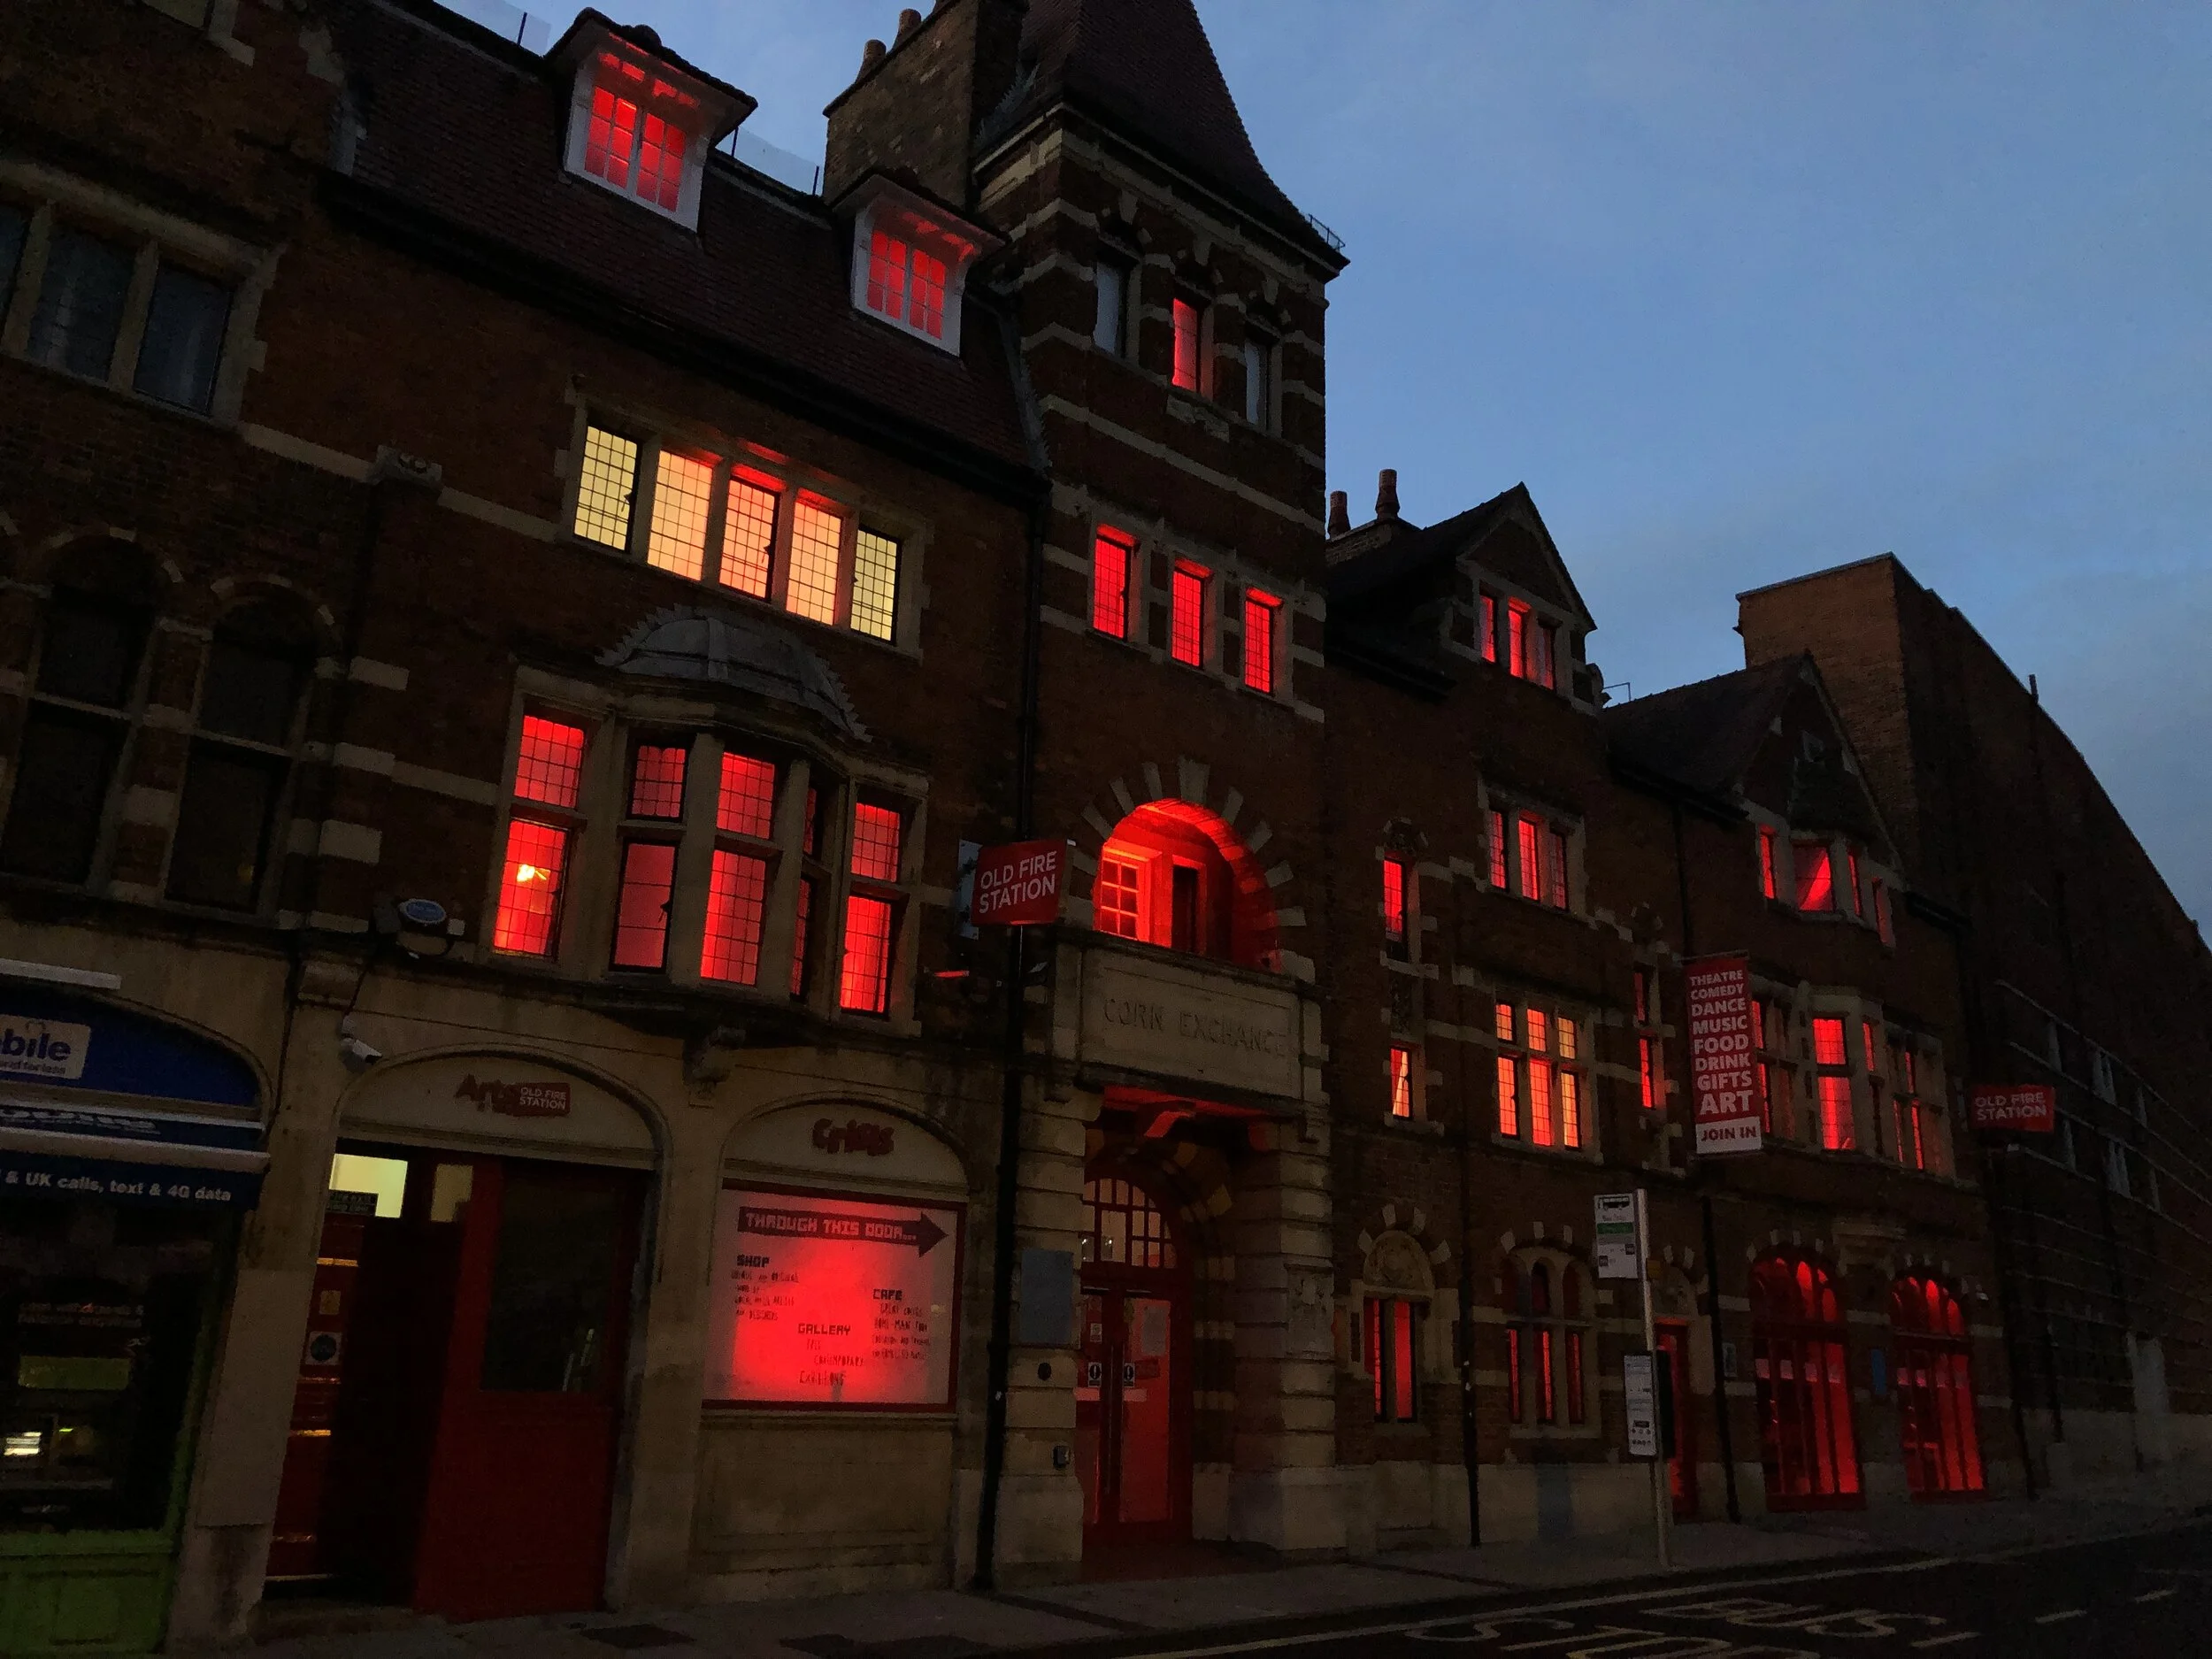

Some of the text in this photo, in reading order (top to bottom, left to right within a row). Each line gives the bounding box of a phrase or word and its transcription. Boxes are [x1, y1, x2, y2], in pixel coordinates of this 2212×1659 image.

[980, 850, 1057, 889] OLD FIRE
[979, 873, 1056, 913] STATION
[1689, 970, 1744, 987] THEATRE
[1691, 983, 1744, 1000] COMEDY
[1103, 998, 1164, 1032] CORN
[1692, 997, 1747, 1017] DANCE
[1693, 1015, 1747, 1034] MUSIC
[0, 1029, 71, 1061] bile
[1694, 1033, 1748, 1054] FOOD
[1695, 1053, 1751, 1071] DRINK
[1697, 1071, 1752, 1091] GIFTS
[520, 1087, 566, 1101] OLD FIRE
[1700, 1090, 1753, 1115] ART
[1975, 1092, 2046, 1108] OLD FIRE
[519, 1097, 565, 1110] STATION
[1977, 1104, 2047, 1120] STATION
[1701, 1126, 1756, 1141] JOIN IN
[26, 1171, 52, 1187] UK
[110, 1179, 142, 1194] text
[195, 1187, 232, 1202] data
[746, 1212, 818, 1233] THROUGH
[823, 1219, 859, 1236] THIS
[736, 1254, 770, 1268] SHOP
[872, 1288, 902, 1301] CAFE
[798, 1323, 850, 1336] GALLERY
